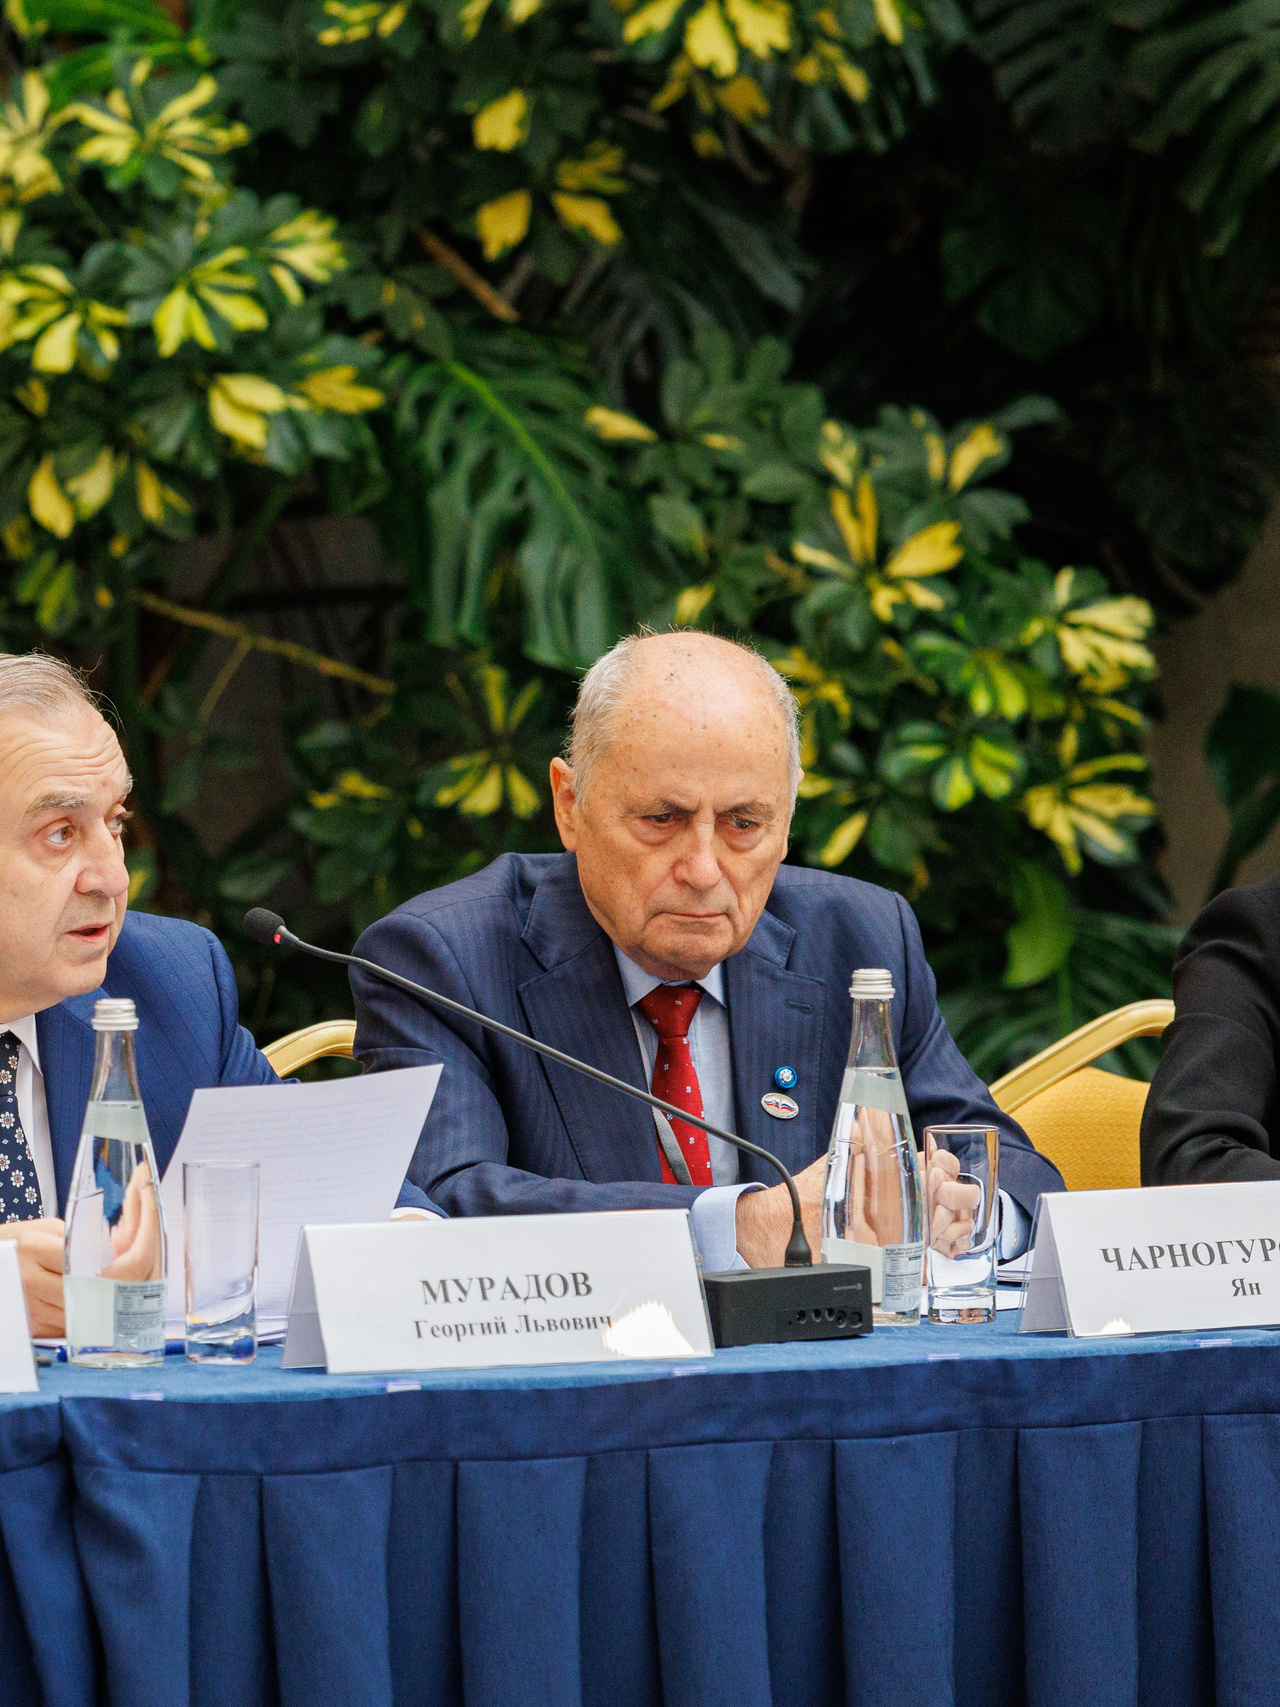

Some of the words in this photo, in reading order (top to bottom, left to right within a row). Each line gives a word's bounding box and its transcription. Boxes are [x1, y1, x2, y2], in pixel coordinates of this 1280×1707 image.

[1100, 1237, 1280, 1272] ЧАРНОГУР
[420, 1271, 593, 1305] МУРАДОВ
[1231, 1277, 1262, 1297] Ян
[414, 1316, 507, 1342] Георгий
[515, 1314, 612, 1334] Львович
